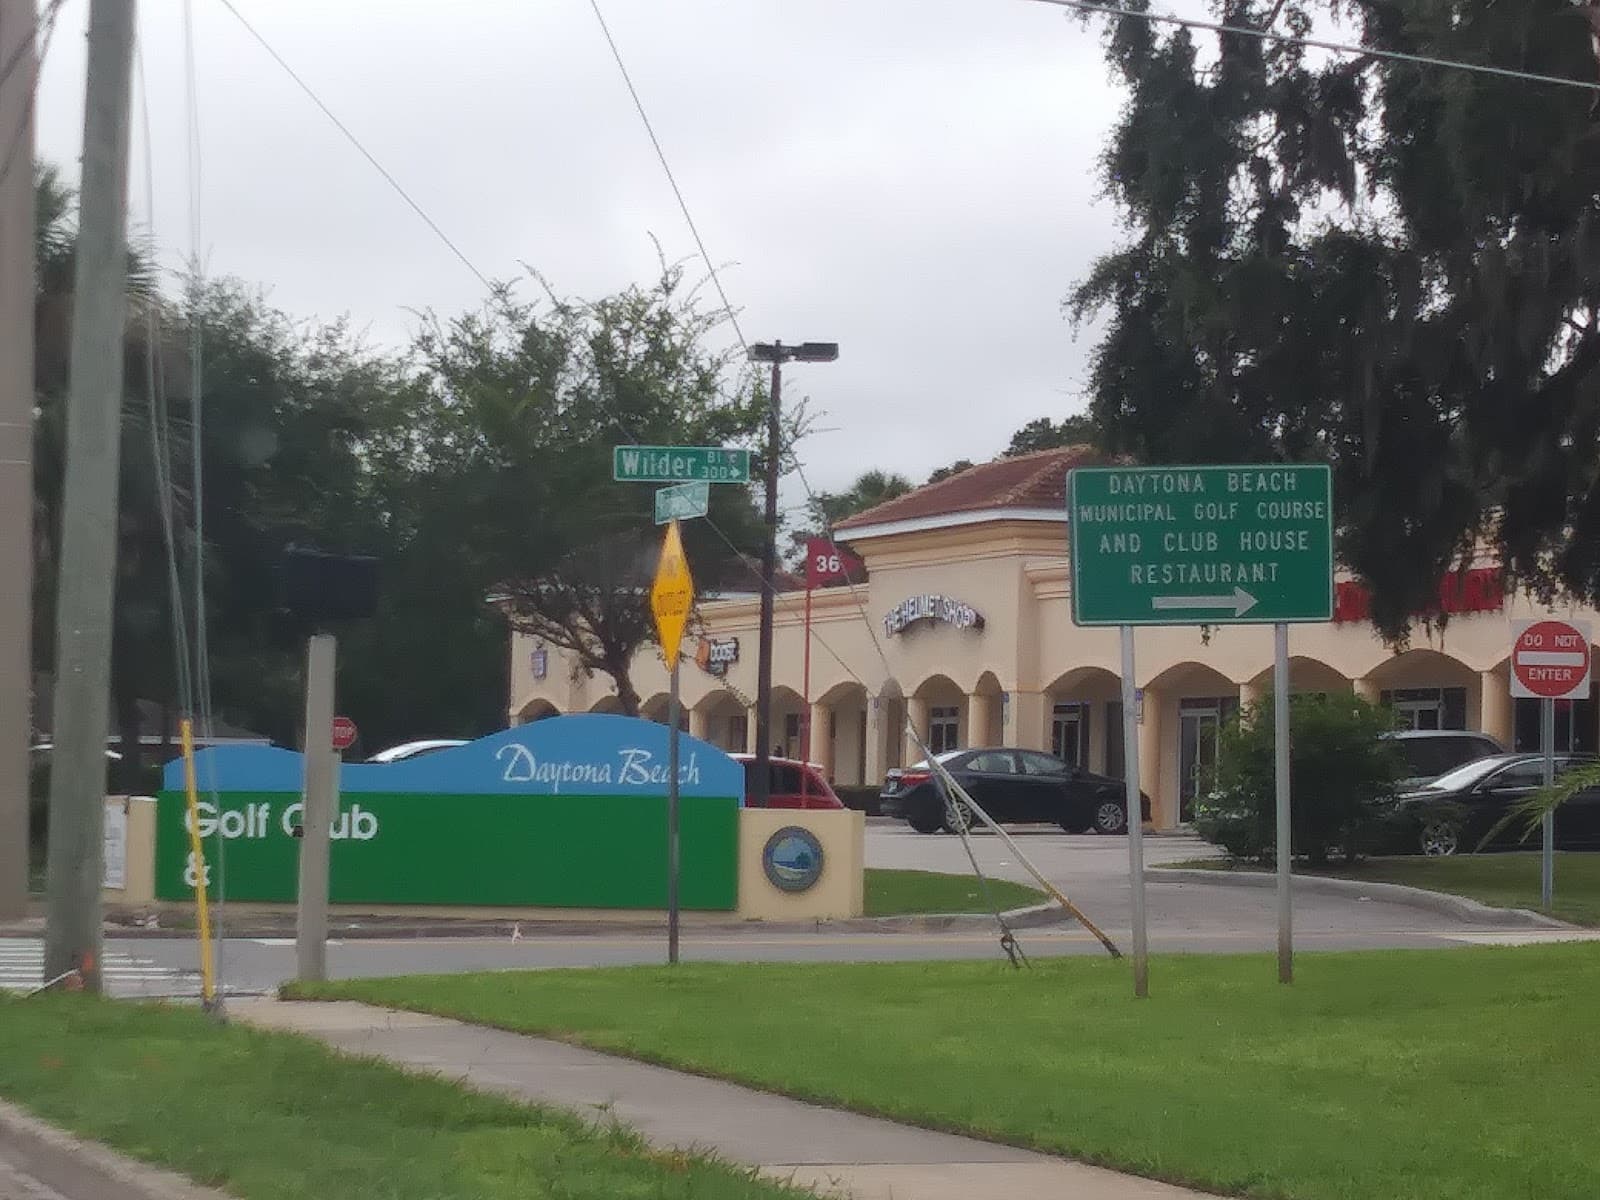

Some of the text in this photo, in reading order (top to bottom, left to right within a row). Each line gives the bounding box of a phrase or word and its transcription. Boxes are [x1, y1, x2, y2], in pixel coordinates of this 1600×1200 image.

[622, 451, 696, 476] Wilder
[1110, 472, 1297, 495] DAYTONA BEACH
[1080, 501, 1325, 522] MUNICIPAL GOLF COURSE
[1099, 530, 1309, 553] AND CLUB HOUSE
[816, 555, 840, 573] 36
[1130, 562, 1279, 585] RESTAURANT
[1524, 633, 1580, 647] DO NOT
[1528, 668, 1573, 681] ENTER
[496, 743, 611, 793] Daytona
[185, 801, 378, 840] Golf Cub
